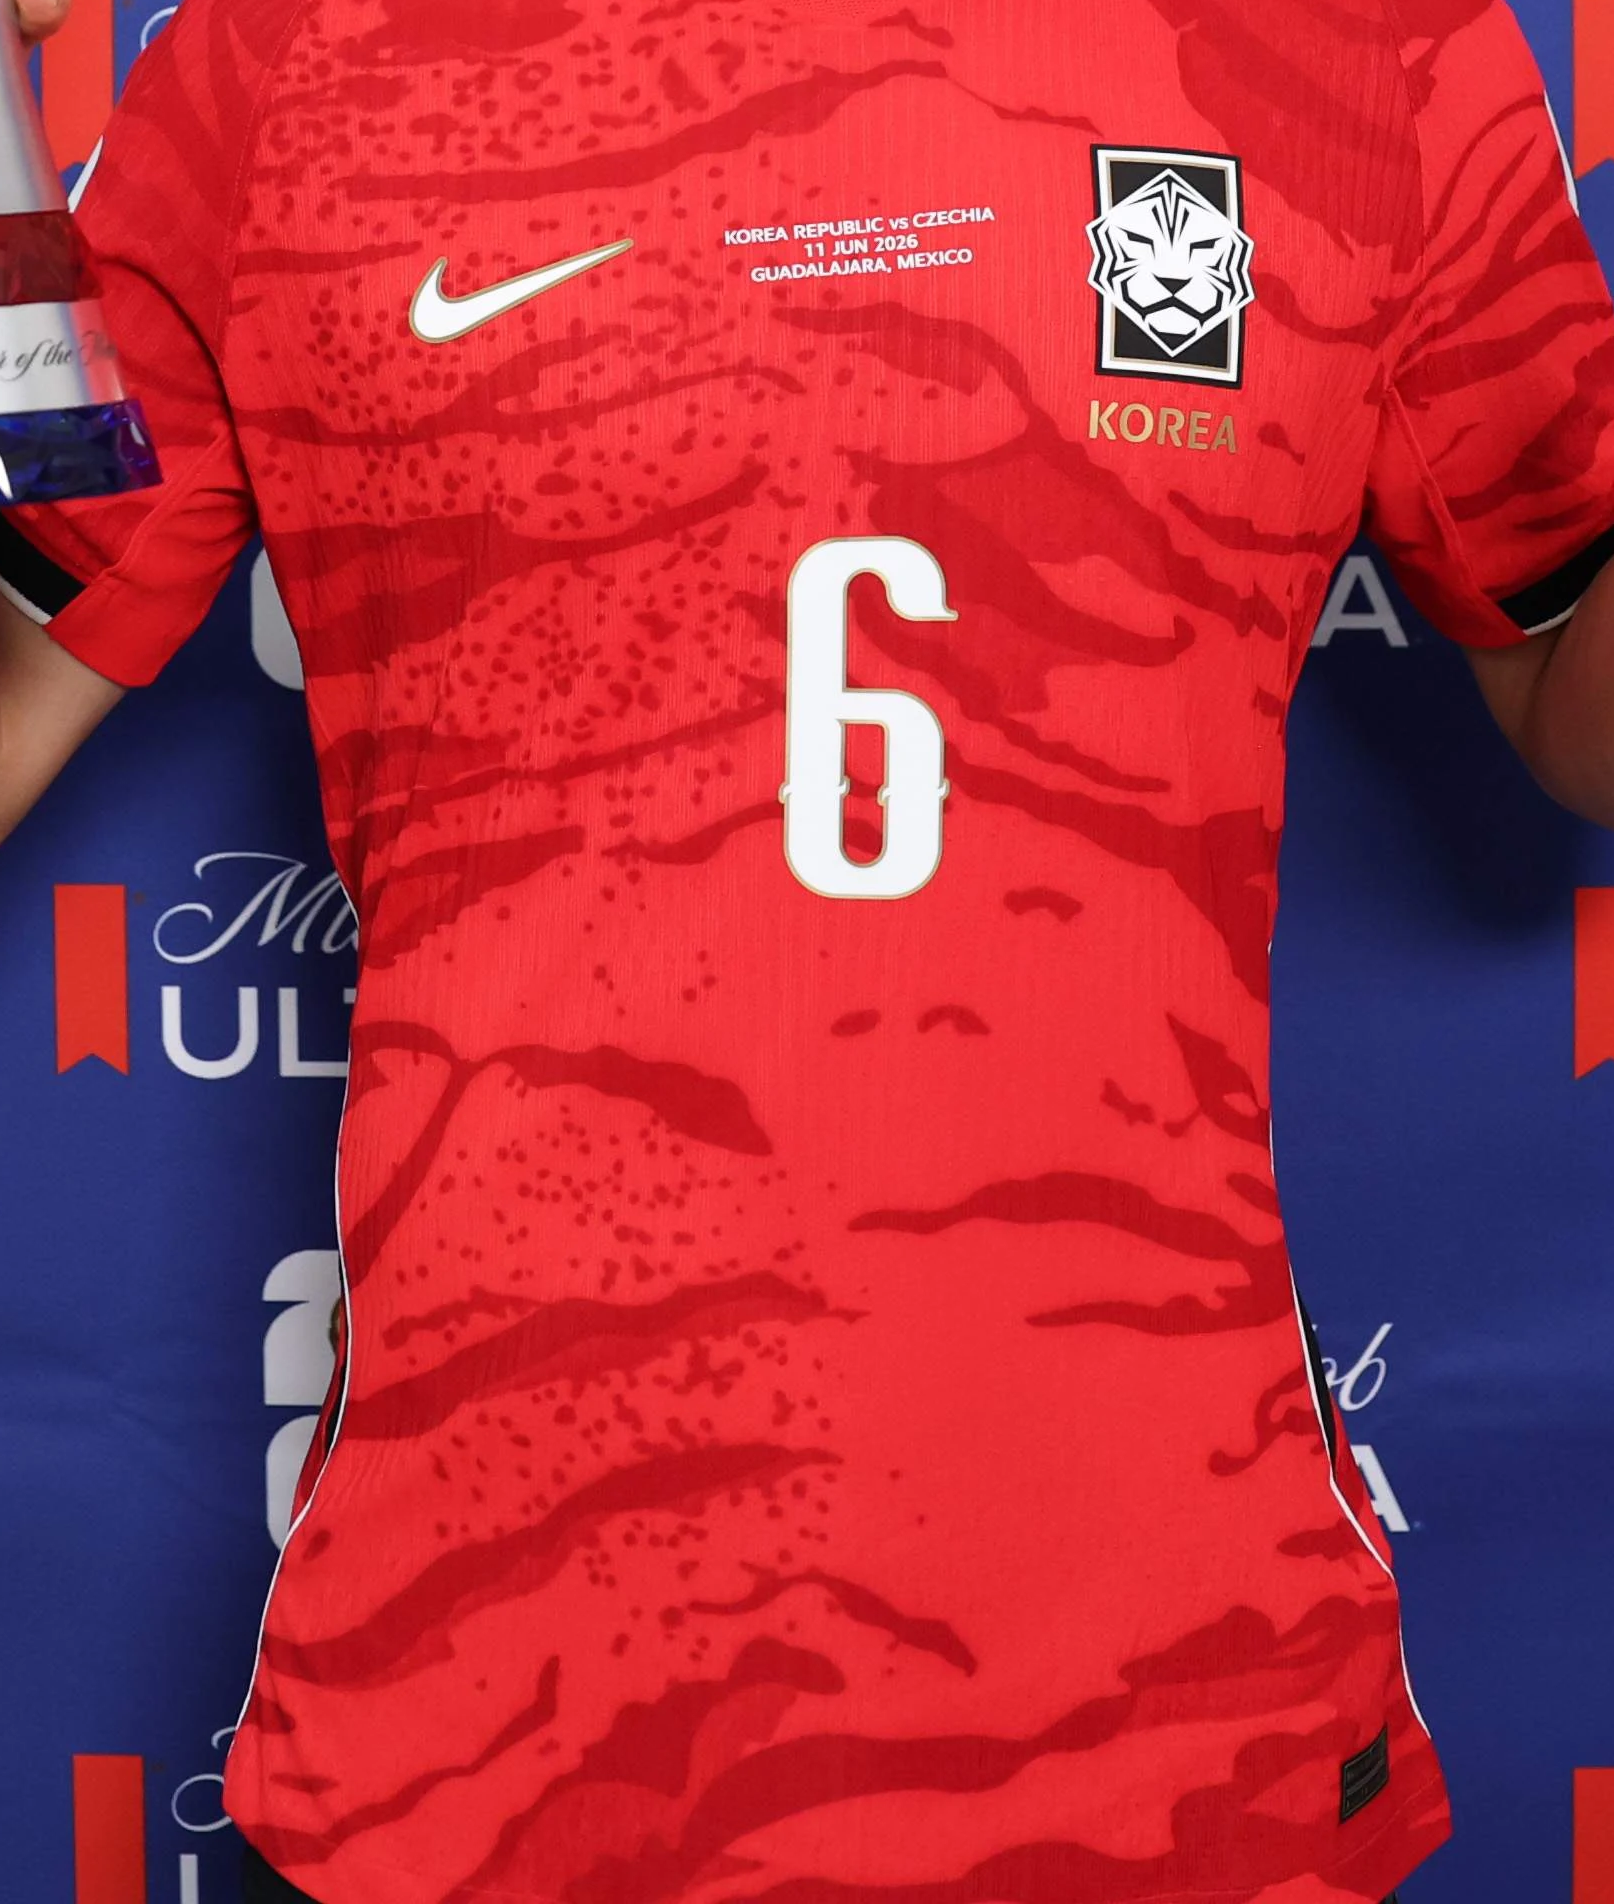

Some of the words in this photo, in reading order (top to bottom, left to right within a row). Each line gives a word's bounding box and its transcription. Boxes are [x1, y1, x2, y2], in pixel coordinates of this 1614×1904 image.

[724, 227, 789, 245] KOREA
[793, 217, 885, 240] REPUBLIC
[912, 207, 995, 229] CZECHIA
[804, 243, 825, 258] 11
[832, 238, 869, 256] JUN
[873, 233, 919, 253] 2026
[750, 260, 893, 283] GUADALAJARA,
[897, 248, 974, 270] MEXICO
[3, 338, 54, 382] of
[43, 338, 73, 368] the
[1088, 400, 1239, 454] KOREA
[778, 535, 960, 900] 6
